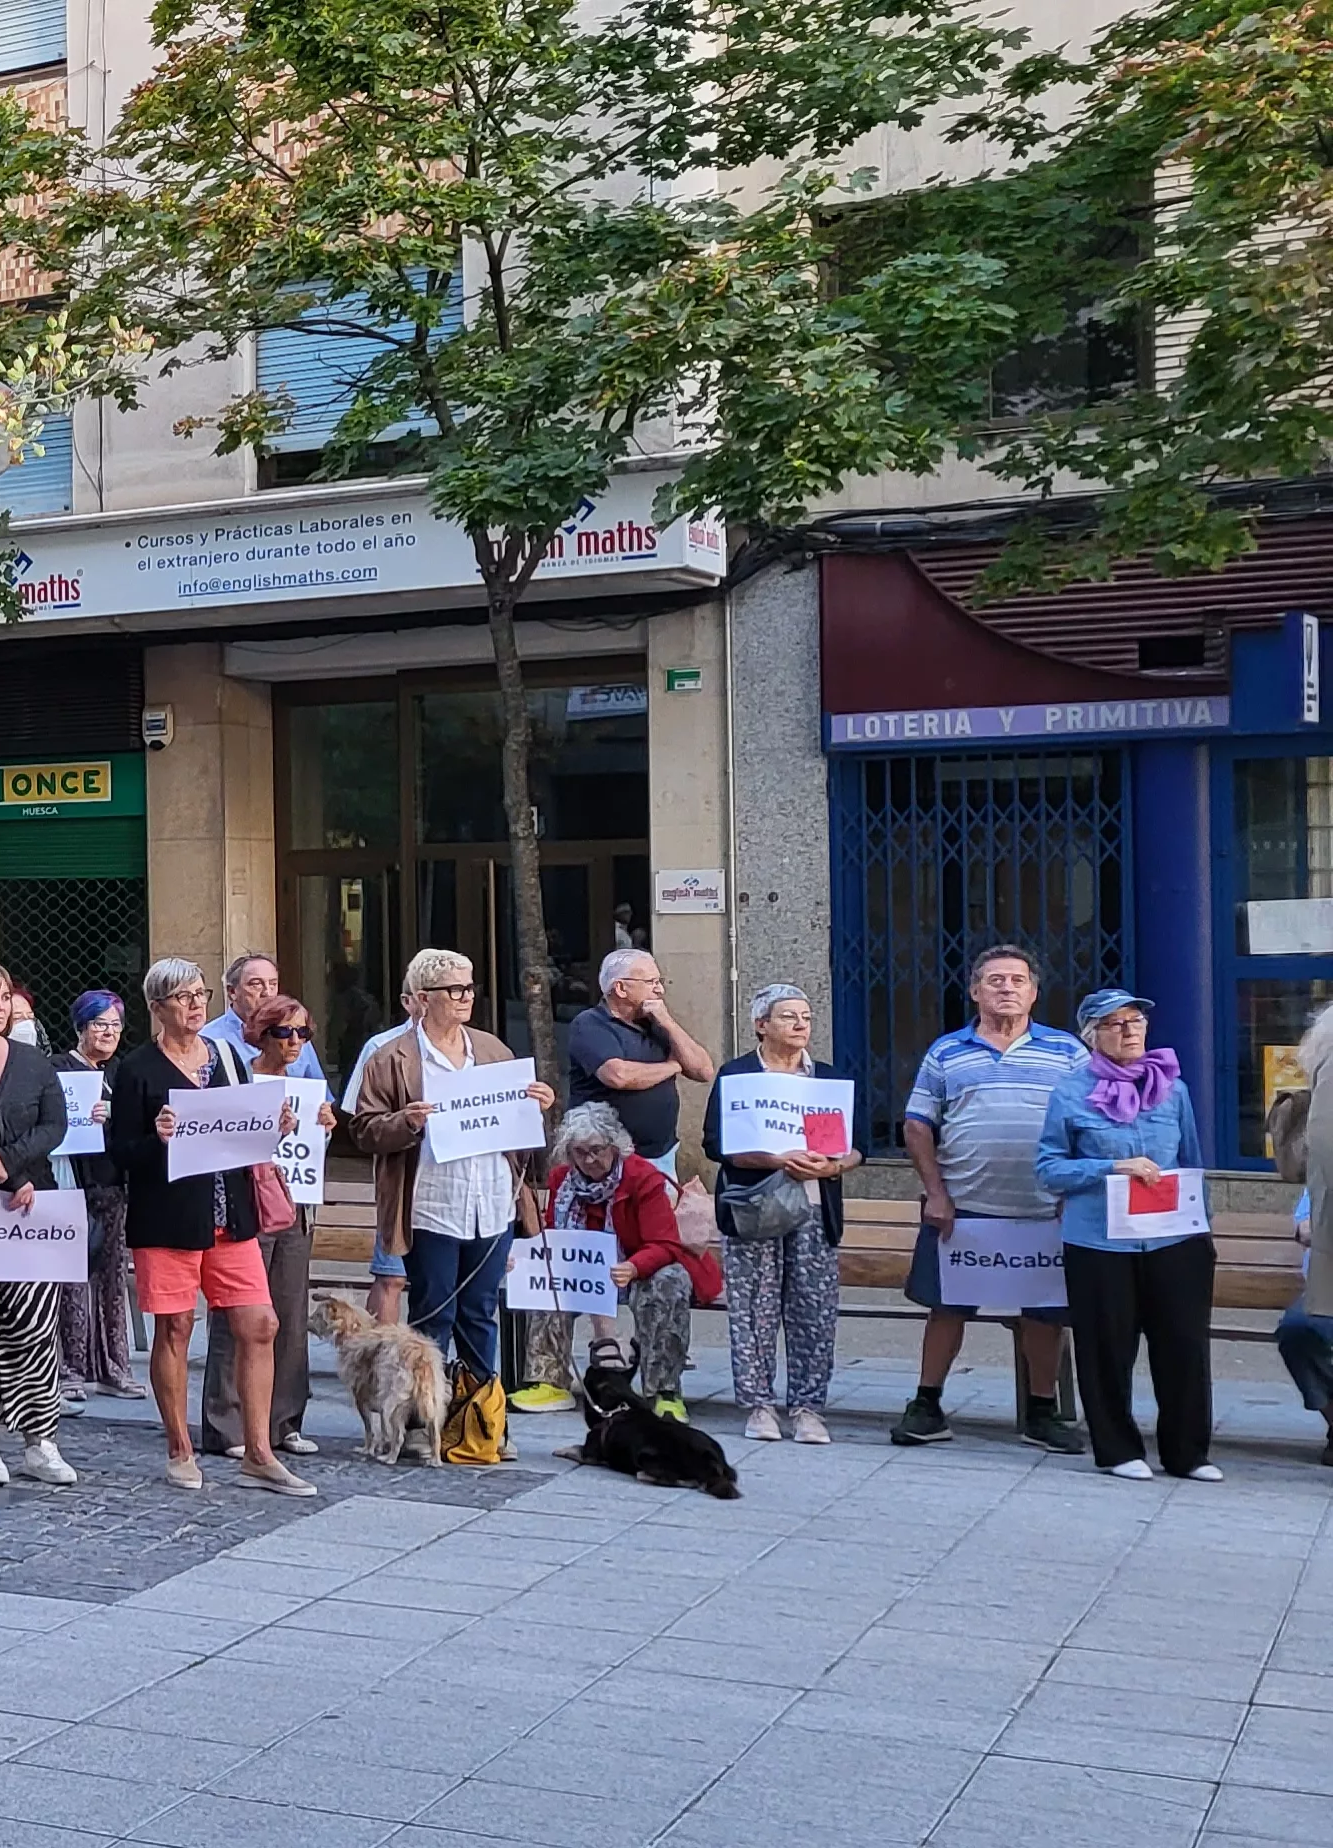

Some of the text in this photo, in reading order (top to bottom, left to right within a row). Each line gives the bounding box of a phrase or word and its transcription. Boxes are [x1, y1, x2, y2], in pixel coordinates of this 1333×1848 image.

[137, 511, 412, 549] Cursos y Prácticas Laborales en
[577, 520, 657, 556] maths
[137, 531, 416, 571] el extranjero durante todo el año
[19, 573, 80, 604] maths
[177, 564, 378, 596] info@englishmaths.com
[846, 699, 1214, 741] LOTERIA Y PRIMITIVA
[11, 770, 101, 796] ONCE
[22, 807, 58, 816] HUESCA
[432, 1089, 528, 1114] EL MACHISMO
[731, 1099, 842, 1116] EL MACHISMO
[175, 1114, 274, 1138] #SeAcabó
[460, 1115, 500, 1132] MATA
[765, 1119, 806, 1137] MATA
[283, 1162, 317, 1185] RÁS
[531, 1247, 606, 1265] NI UNA
[949, 1250, 1064, 1268] #SeAcabó
[530, 1276, 605, 1295] MENOS
